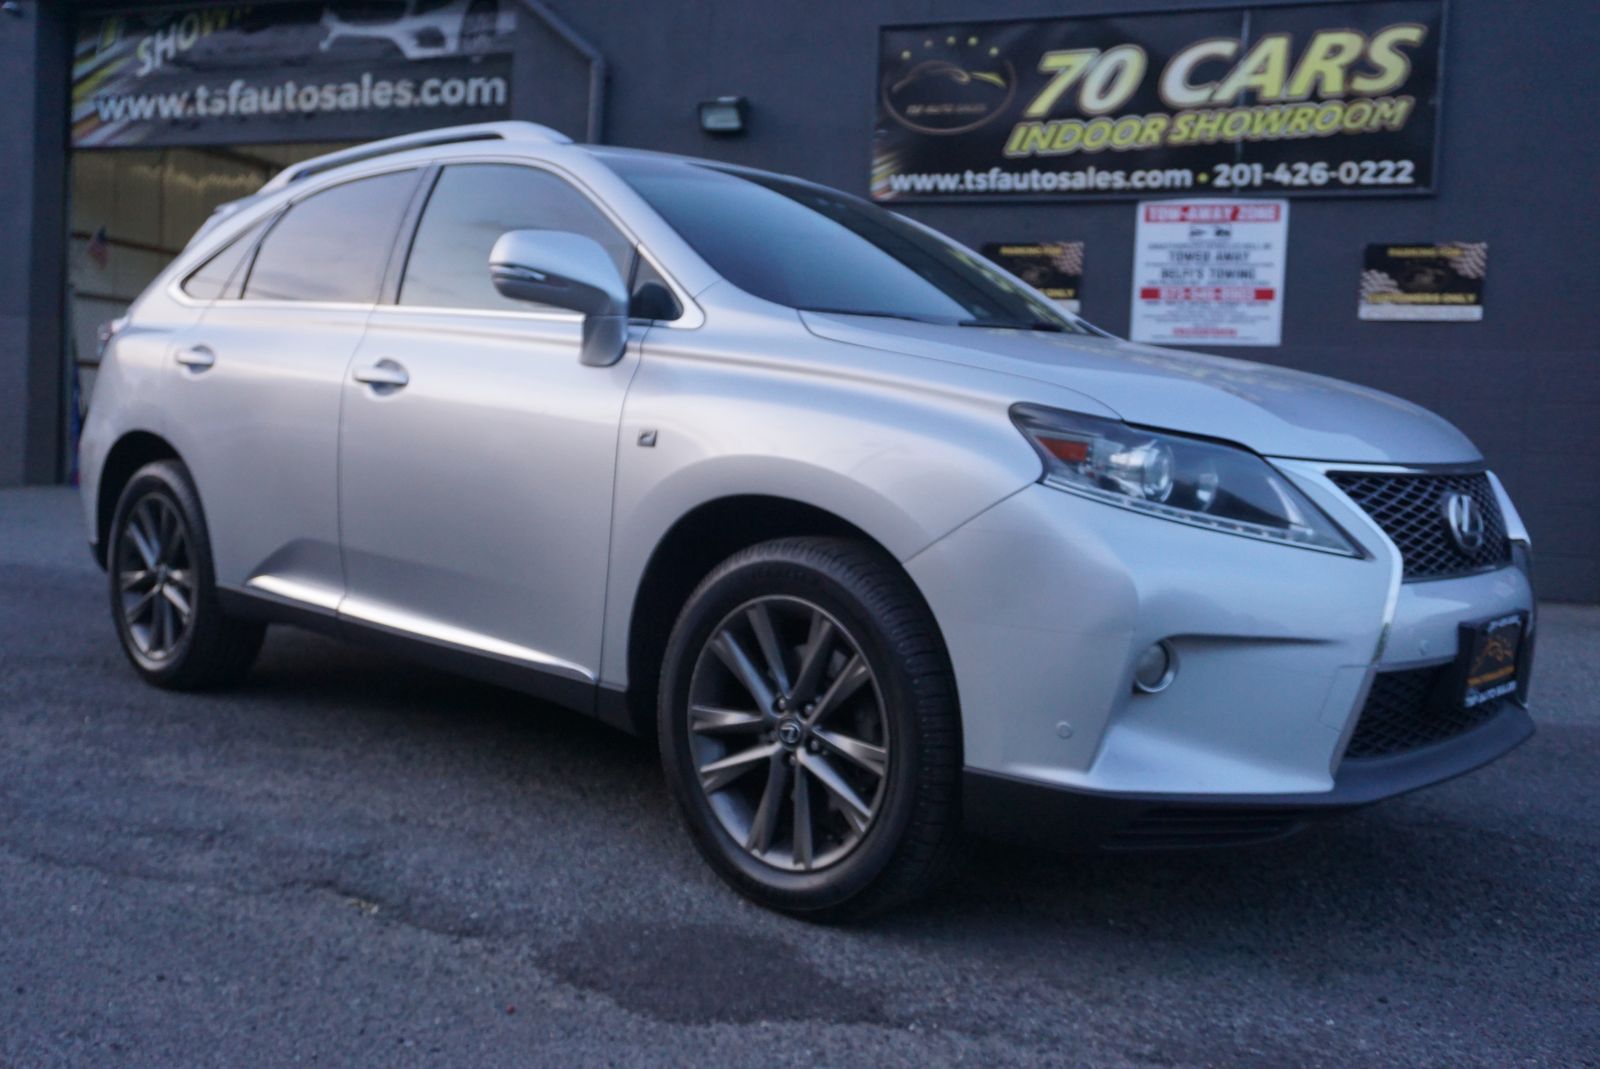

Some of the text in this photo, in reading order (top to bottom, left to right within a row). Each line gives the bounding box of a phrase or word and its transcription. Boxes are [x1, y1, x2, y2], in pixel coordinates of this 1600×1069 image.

[100, 73, 507, 120] www.tsfautosales.com
[1023, 23, 1428, 118] 70 CARS
[1005, 96, 1413, 157] INDOOR SHOWROOM
[890, 160, 1415, 191] www.tsfautosales.com 201-426-0222
